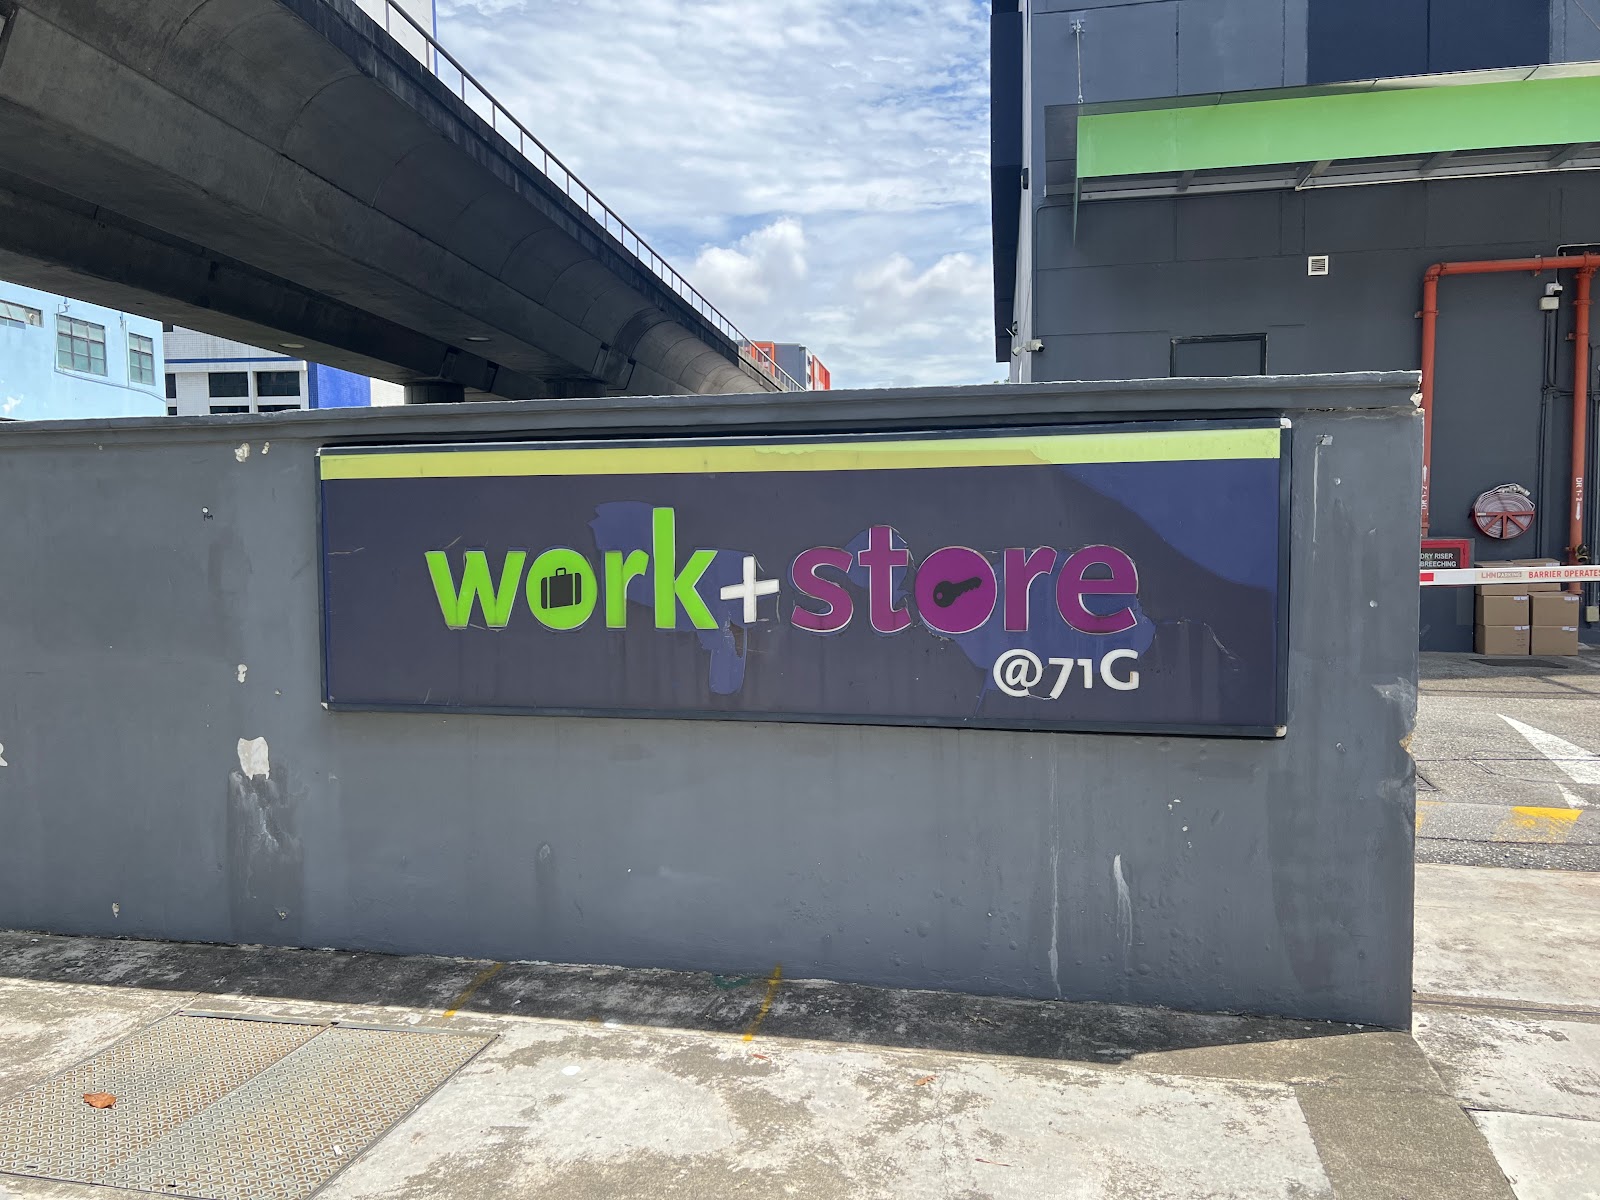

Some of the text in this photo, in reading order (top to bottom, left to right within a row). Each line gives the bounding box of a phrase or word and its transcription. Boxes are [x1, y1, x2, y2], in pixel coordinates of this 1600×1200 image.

[1420, 552, 1454, 560] DRY RISER
[1528, 570, 1562, 579] BARRIER
[993, 648, 1140, 700] @71G
